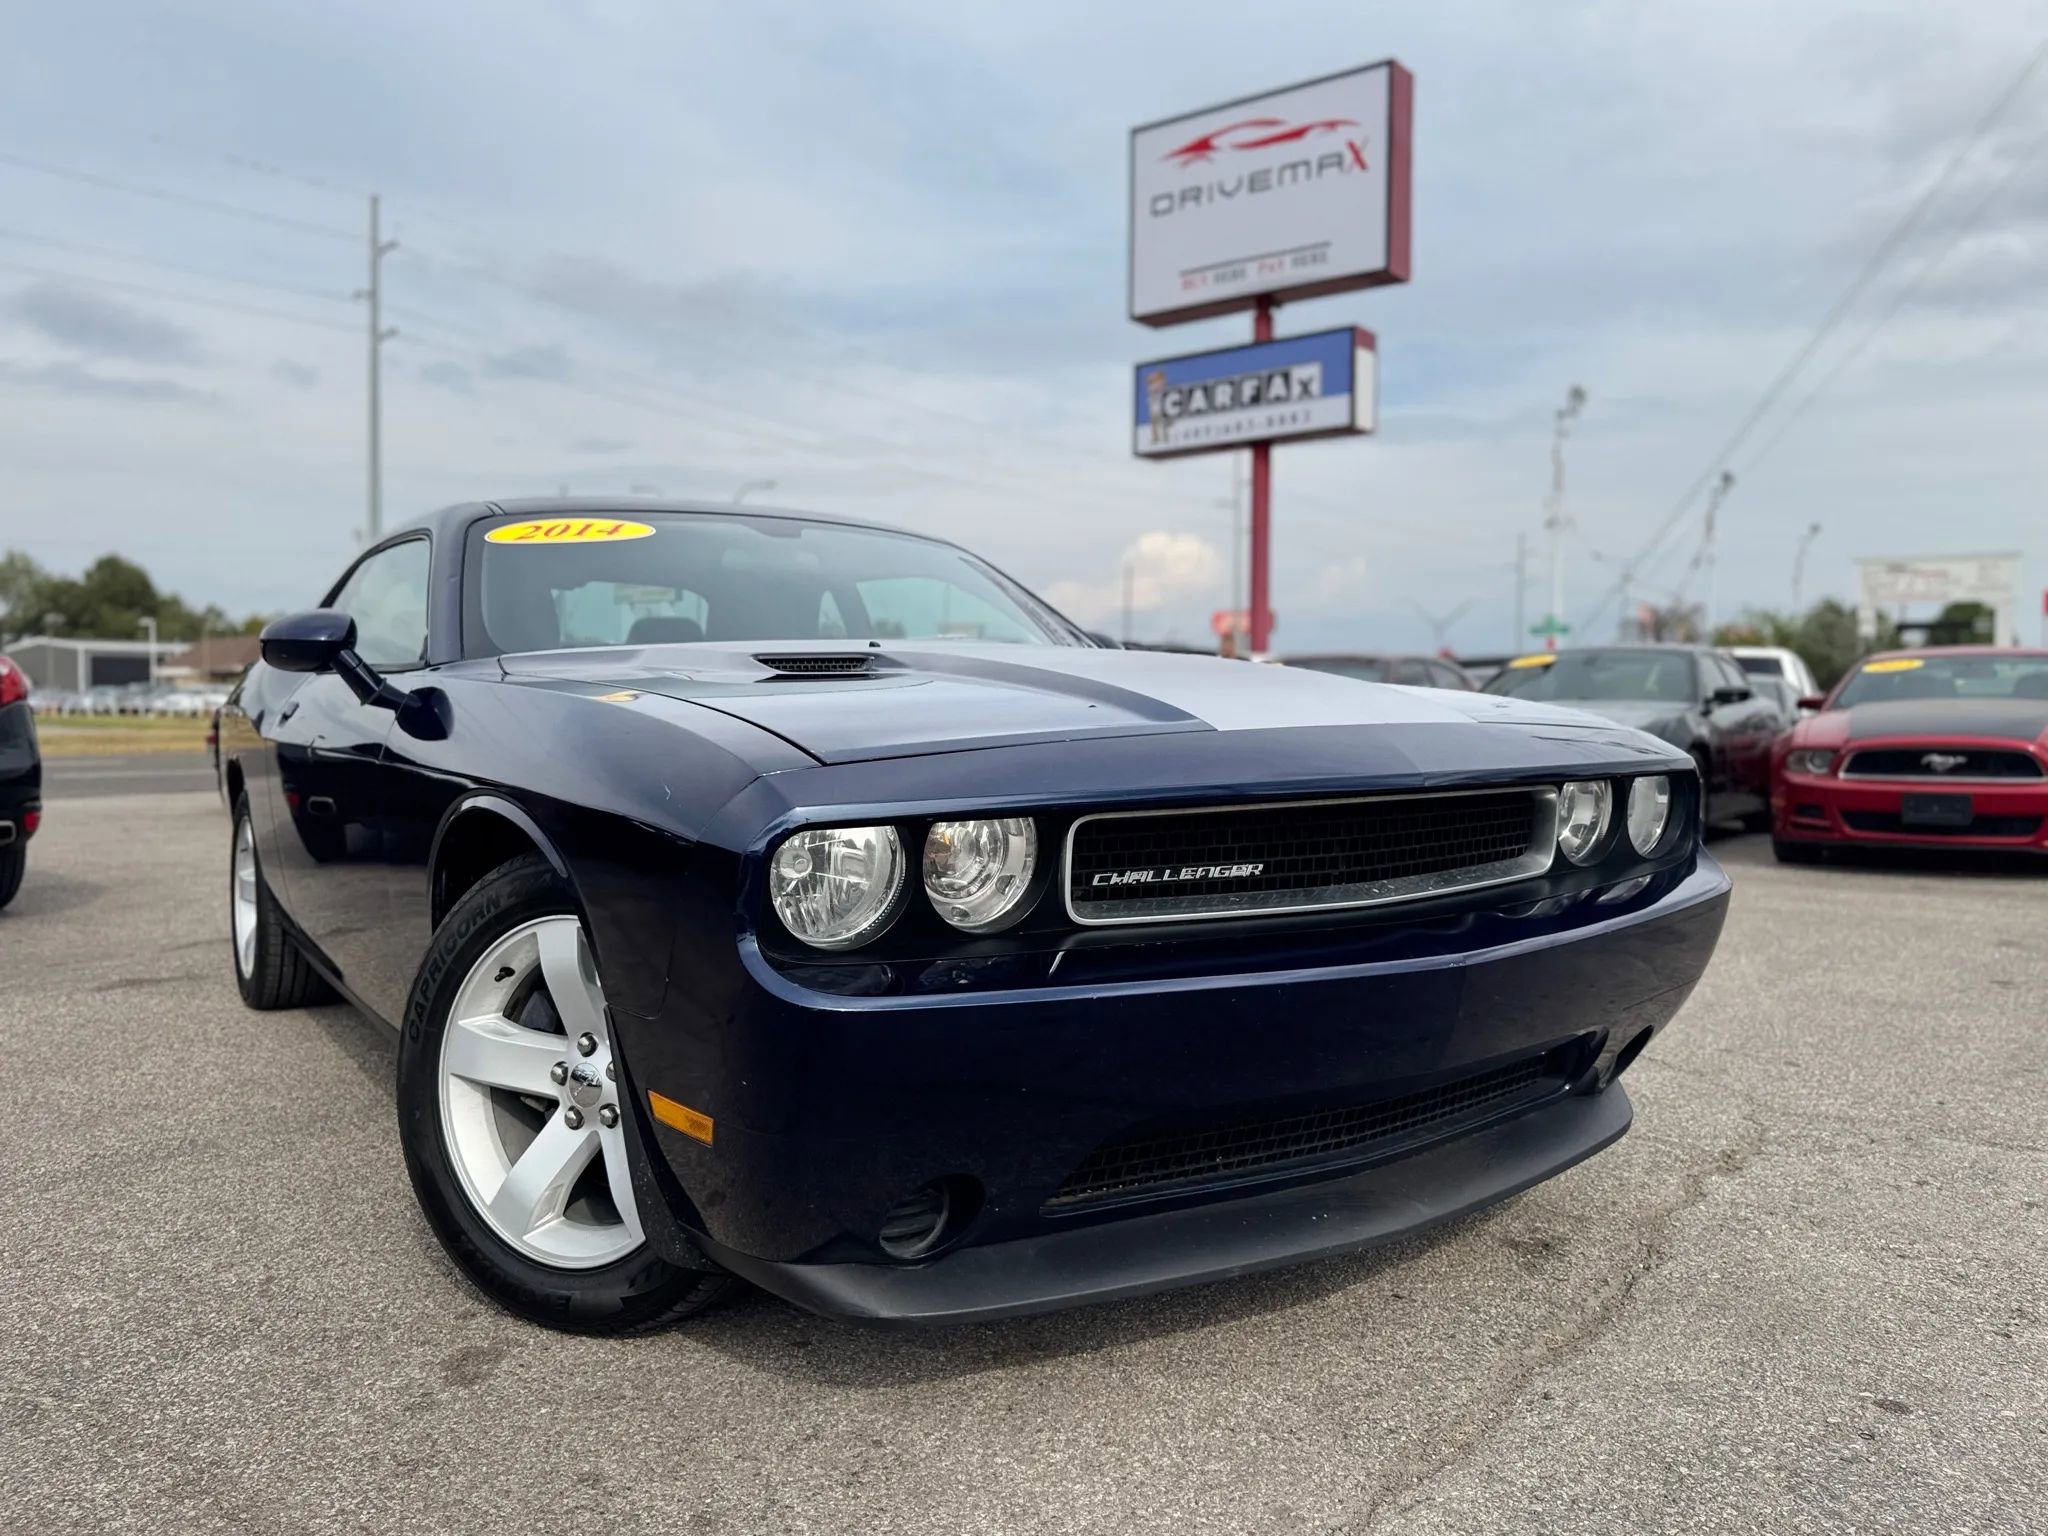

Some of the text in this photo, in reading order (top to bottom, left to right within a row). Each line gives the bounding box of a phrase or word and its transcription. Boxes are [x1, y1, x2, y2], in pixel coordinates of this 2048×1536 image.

[1150, 136, 1369, 217] DRIVEMAX
[1163, 368, 1317, 418] CARFAX
[515, 523, 625, 540] 2014
[1092, 863, 1264, 886] CHALLENGER
[408, 890, 502, 1043] CAPRICORN
